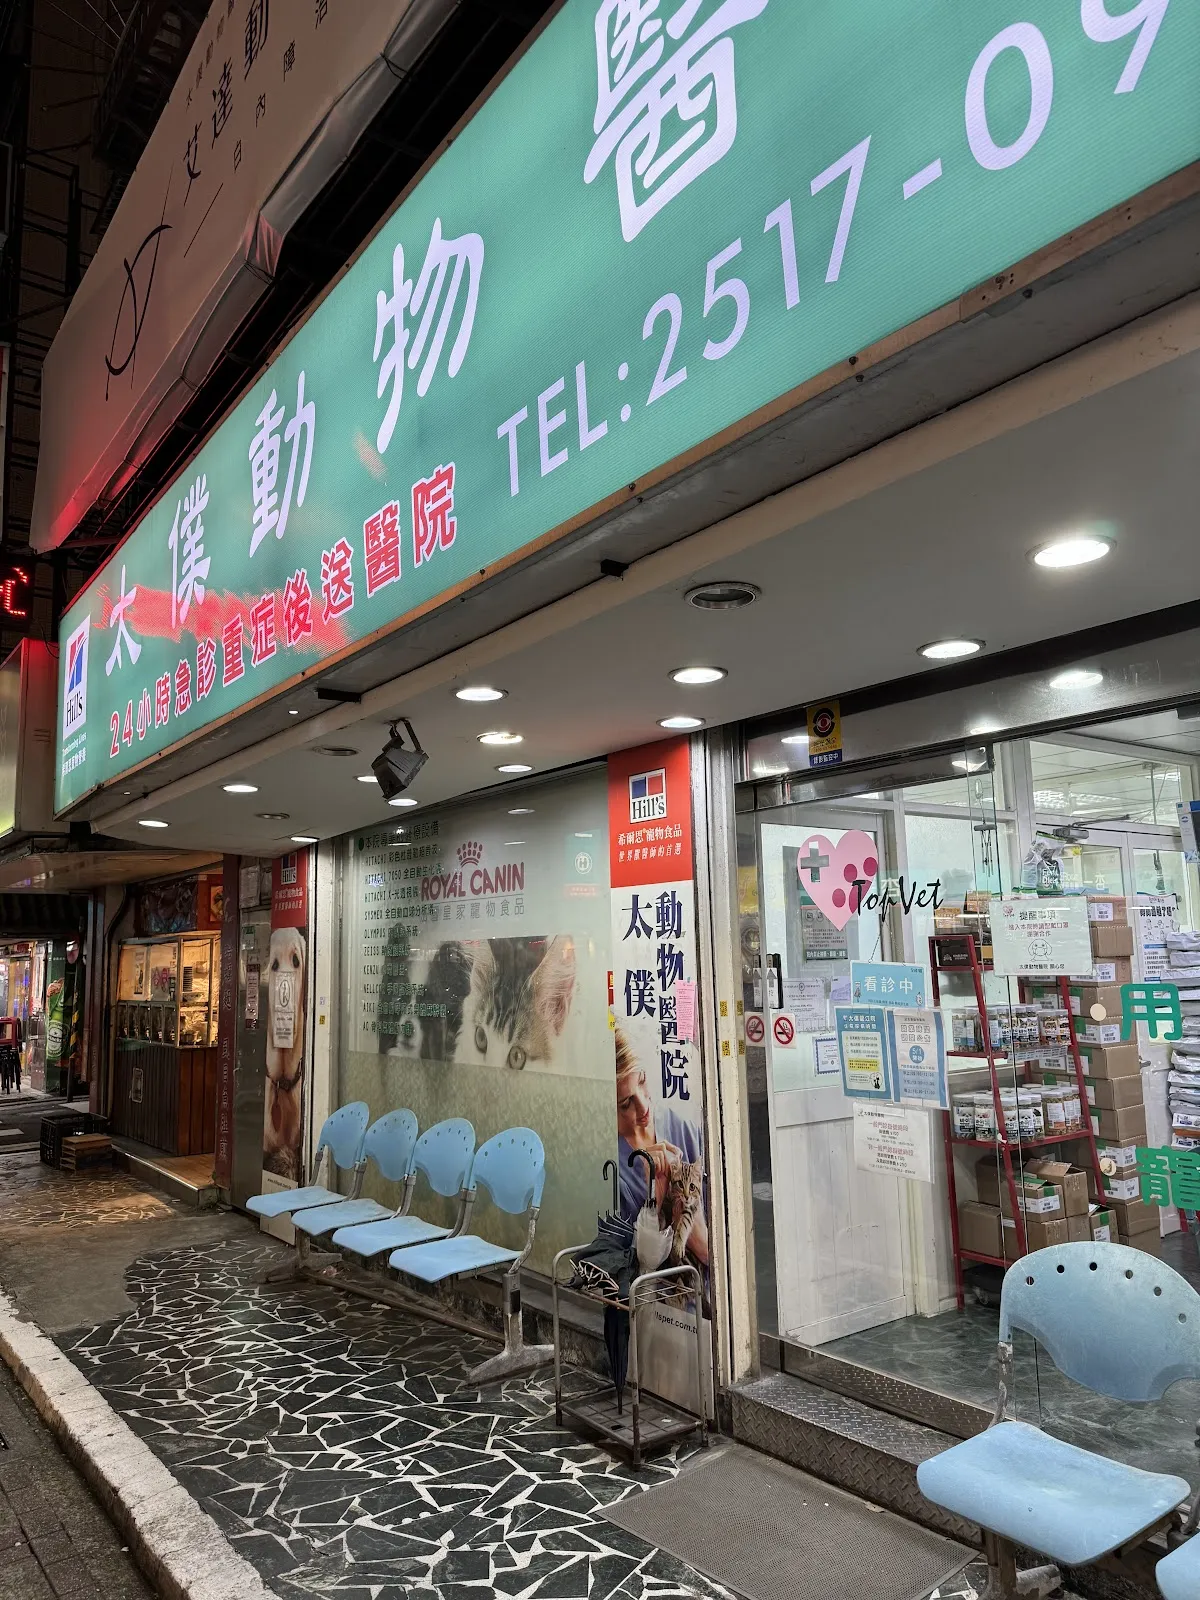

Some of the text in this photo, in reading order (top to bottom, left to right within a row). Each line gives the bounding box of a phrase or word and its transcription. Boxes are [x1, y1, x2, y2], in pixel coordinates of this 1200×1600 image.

[109, 461, 458, 759] 24小時急診重症後送醫院
[66, 692, 83, 727] Hill's
[632, 796, 665, 819] Hill's
[420, 861, 525, 902] ROYAL CANIN
[364, 927, 386, 939] OLYMPUS
[621, 894, 657, 1018] 太僕
[655, 890, 690, 1101] 動物醫院
[864, 976, 913, 995] 看診中
[1120, 984, 1182, 1041] 用
